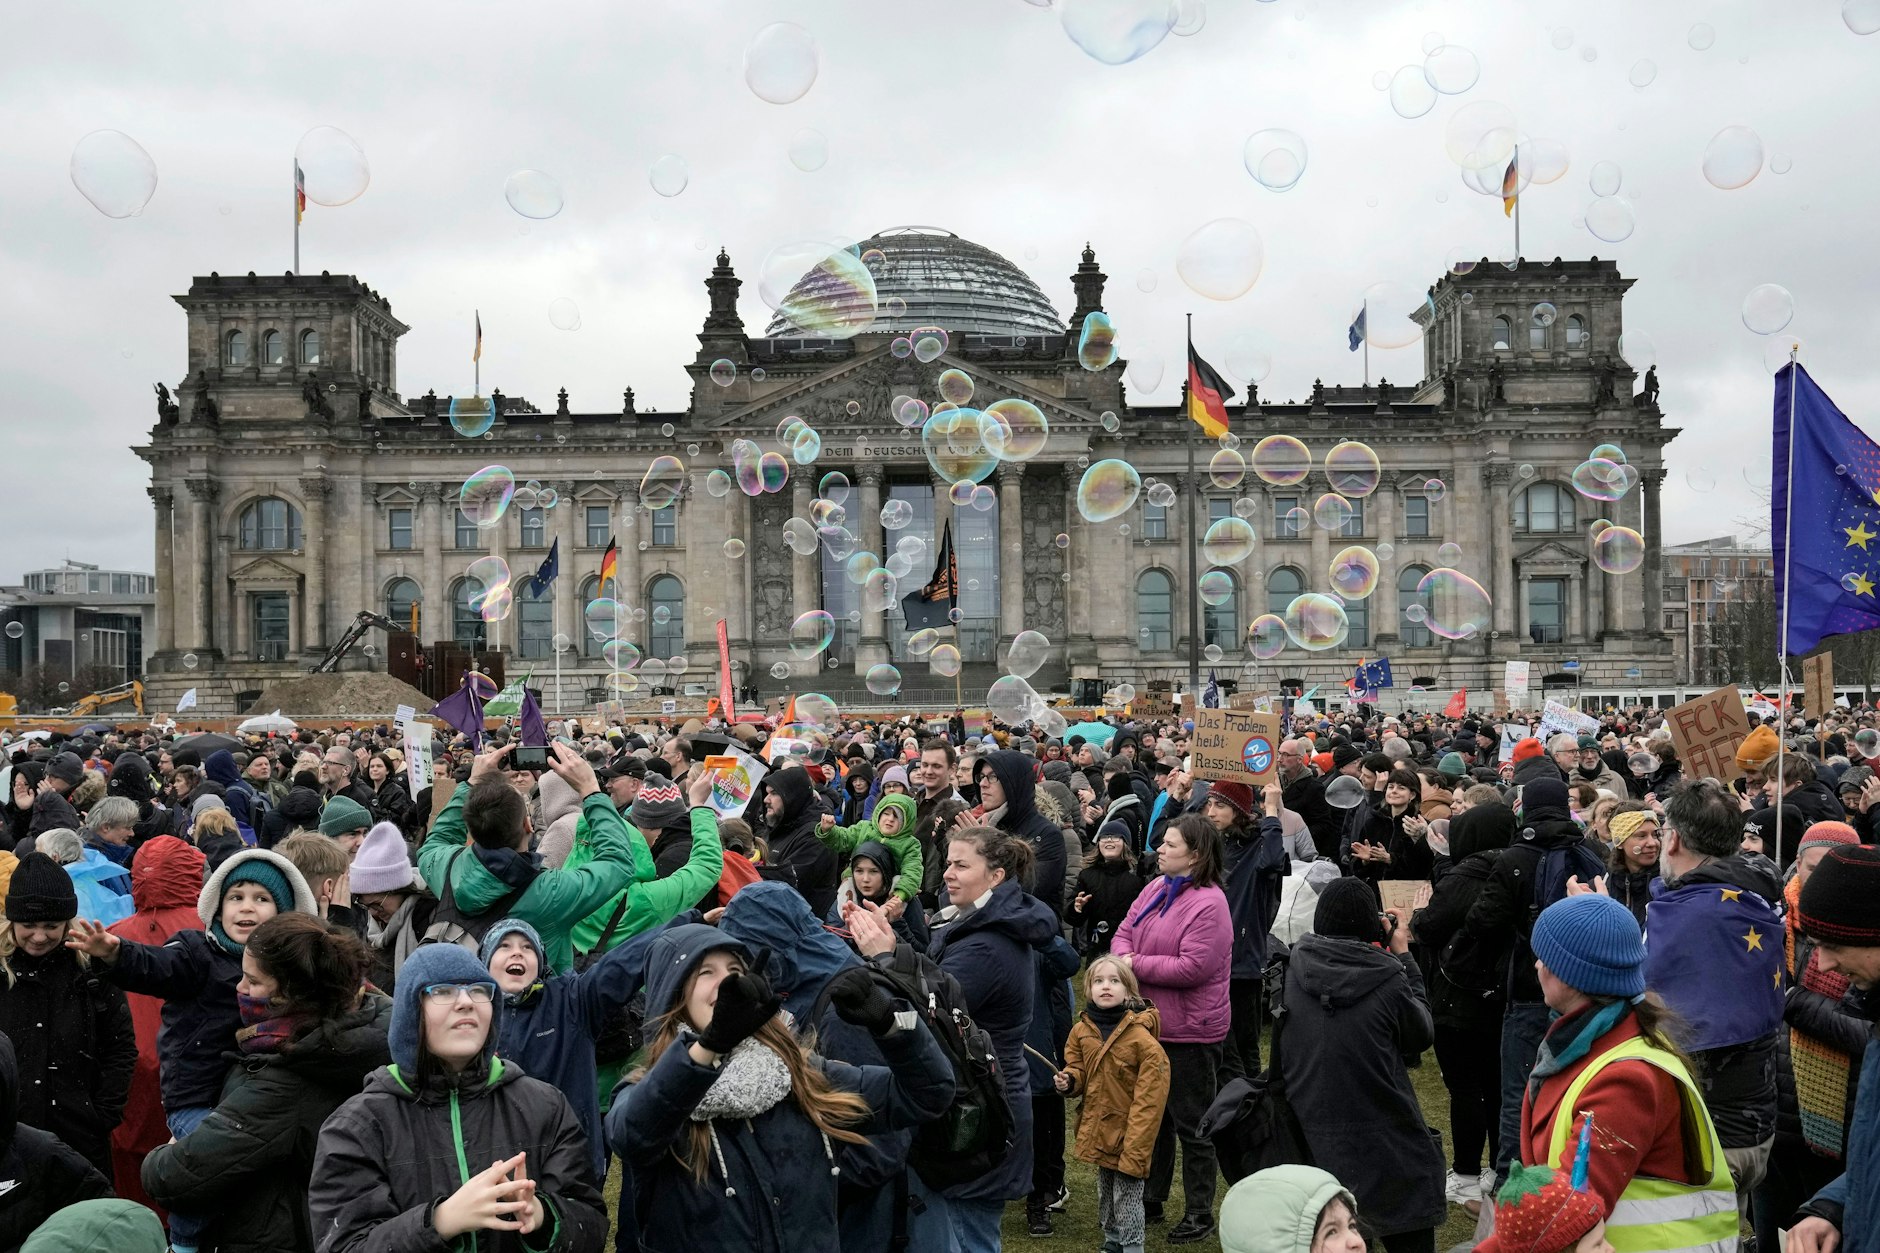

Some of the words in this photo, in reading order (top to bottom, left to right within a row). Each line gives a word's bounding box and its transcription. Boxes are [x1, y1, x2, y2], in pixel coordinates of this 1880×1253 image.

[825, 447, 853, 457] DEM
[864, 446, 937, 456] DEUTSCHEN
[1132, 707, 1173, 716] INTOLERANZ
[1673, 694, 1739, 746] FCK
[1198, 711, 1220, 729] Das
[1223, 712, 1268, 734] Problem
[1196, 732, 1229, 749] heißt:
[1194, 752, 1257, 773] Rassismus
